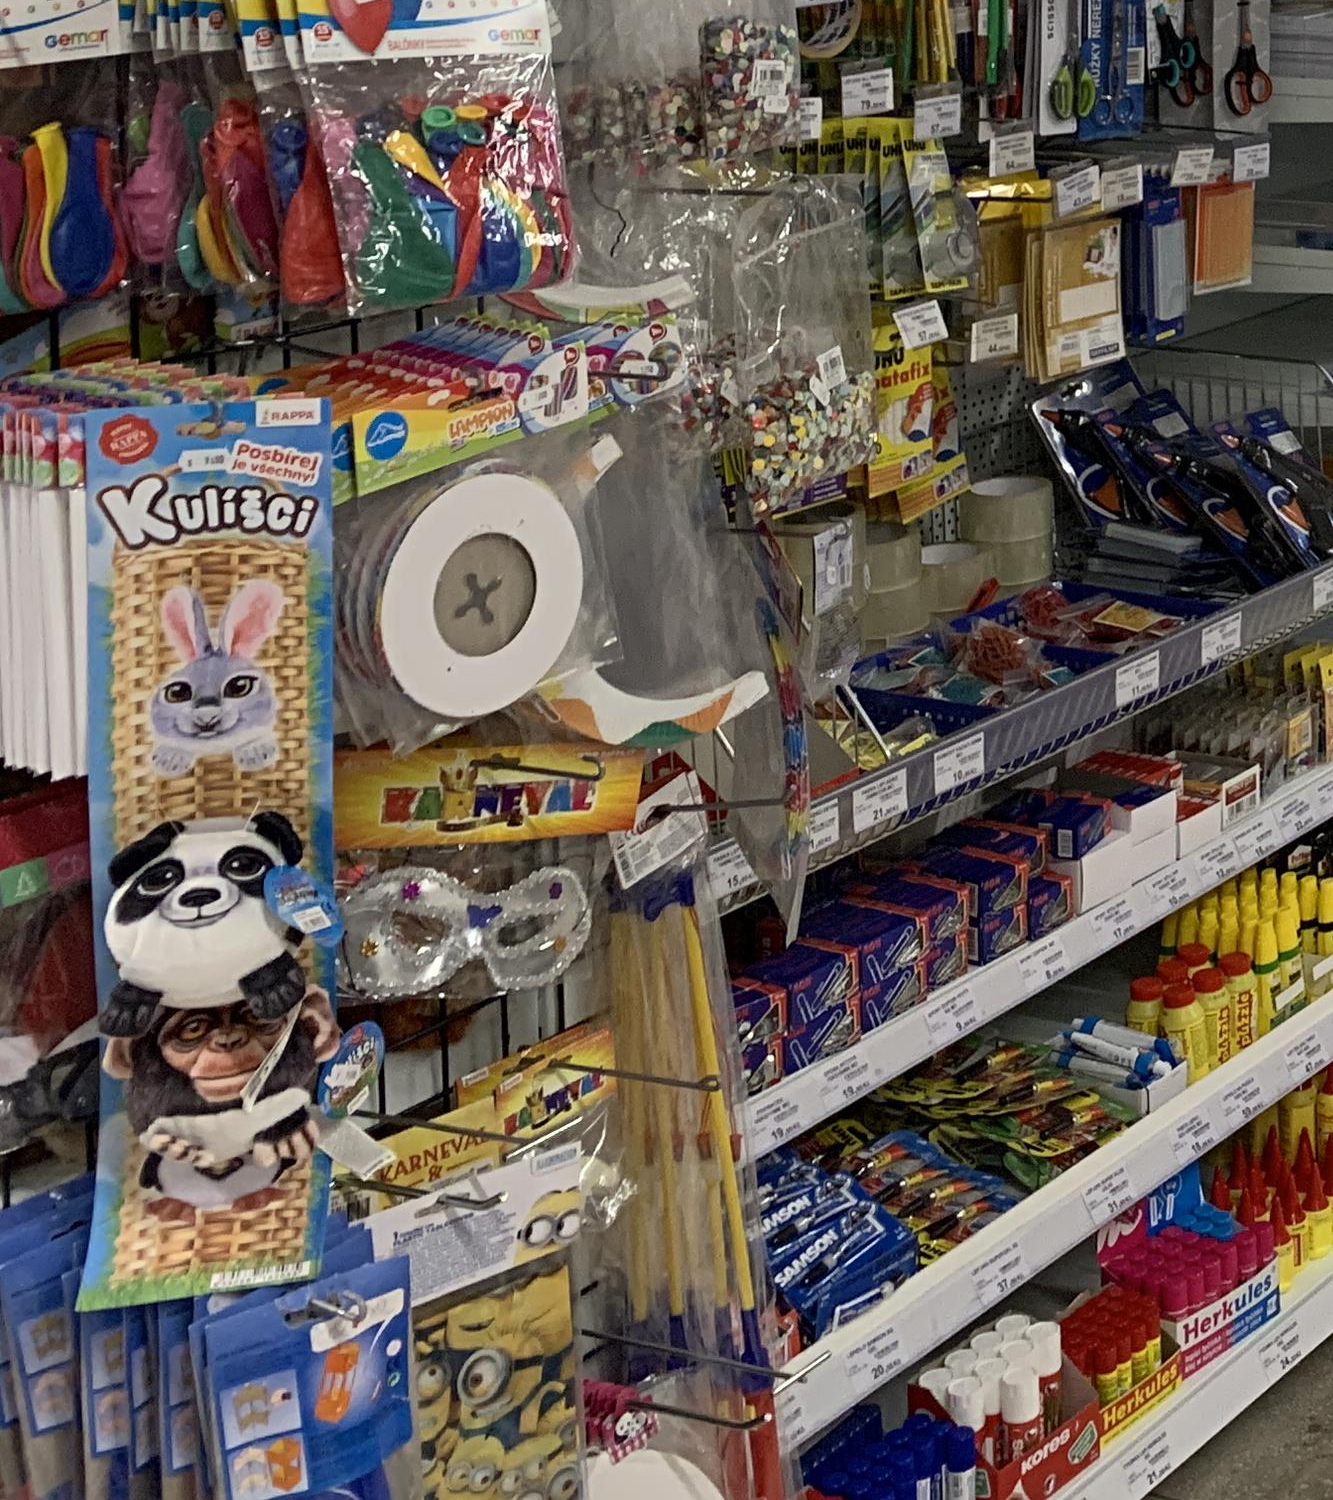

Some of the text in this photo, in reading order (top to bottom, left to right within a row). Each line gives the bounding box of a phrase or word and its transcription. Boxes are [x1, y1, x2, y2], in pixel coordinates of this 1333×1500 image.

[271, 410, 315, 421] RAPPA
[231, 458, 247, 471] je
[250, 462, 316, 483] všechny!
[236, 443, 319, 471] Posbírej
[98, 475, 318, 548] Kulíšci
[774, 1228, 839, 1287] SAMSON
[1183, 1273, 1272, 1344] Herkules
[1103, 1363, 1179, 1431] Herkules
